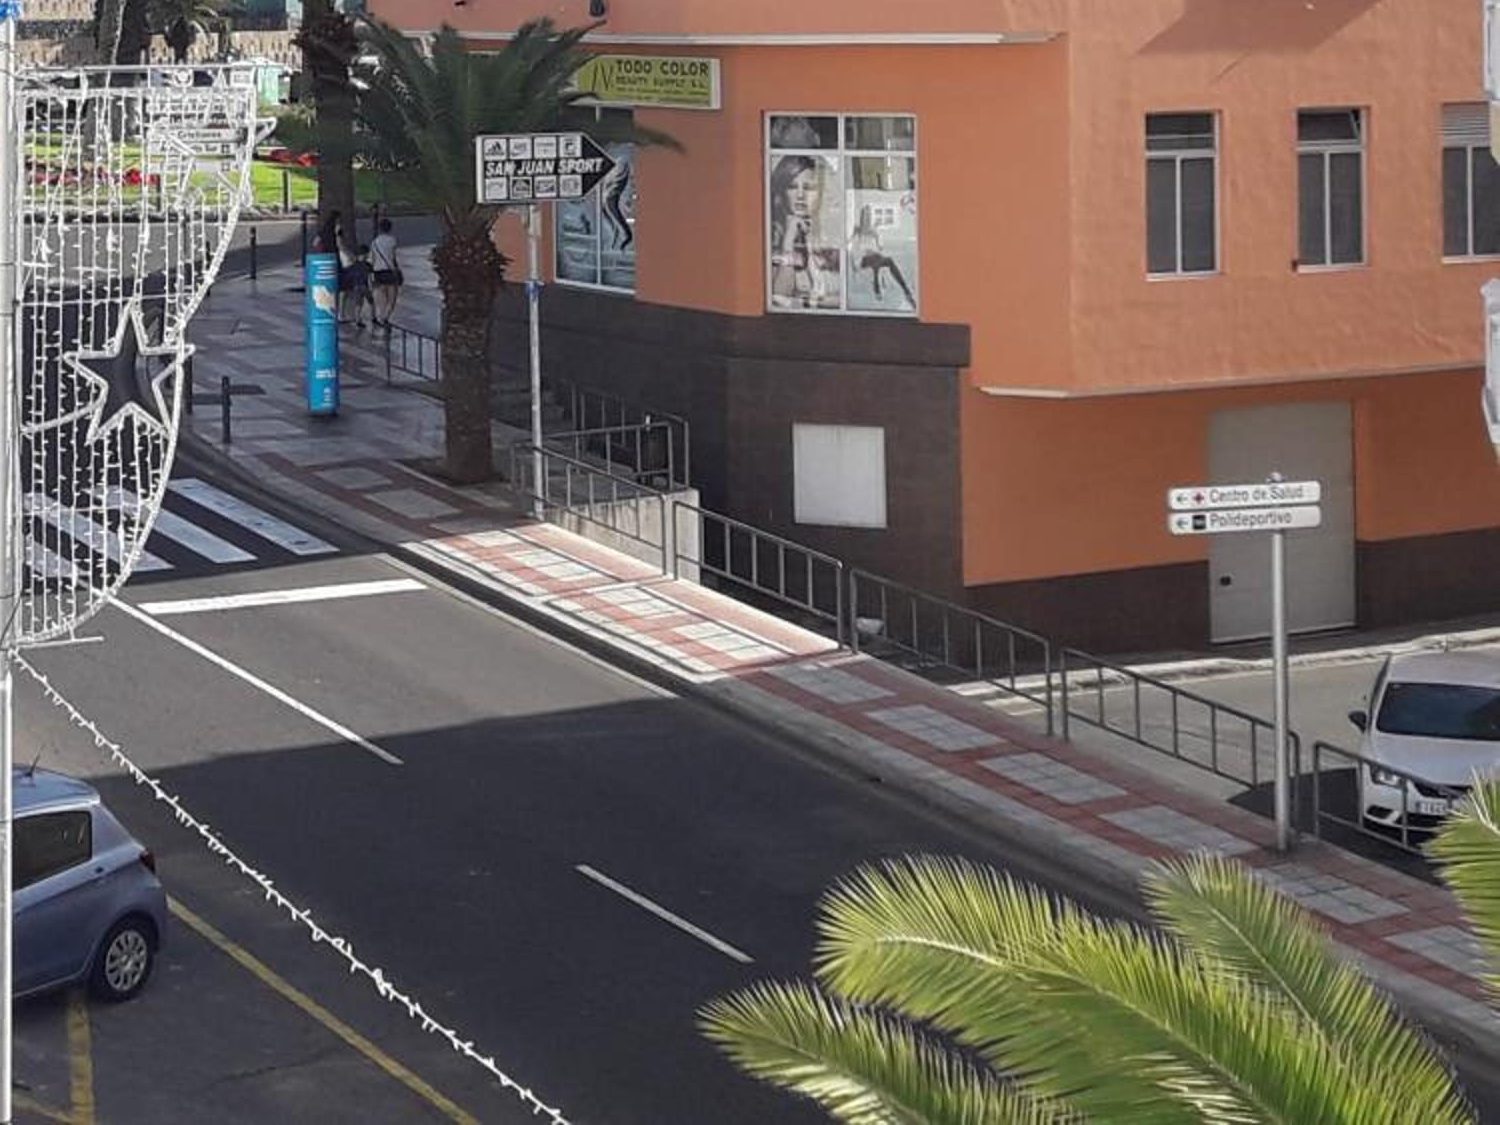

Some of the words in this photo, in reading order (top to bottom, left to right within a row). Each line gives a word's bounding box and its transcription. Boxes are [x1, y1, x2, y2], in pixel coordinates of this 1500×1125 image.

[615, 59, 652, 75] TODO
[660, 60, 709, 76] COLOR
[485, 160, 516, 177] SAN
[517, 159, 555, 176] JUAN
[558, 157, 604, 174] SPORT
[1210, 488, 1249, 504] Centro
[1252, 487, 1267, 500] de
[1271, 485, 1304, 500] Salud
[1210, 510, 1293, 527] Polideportivo
